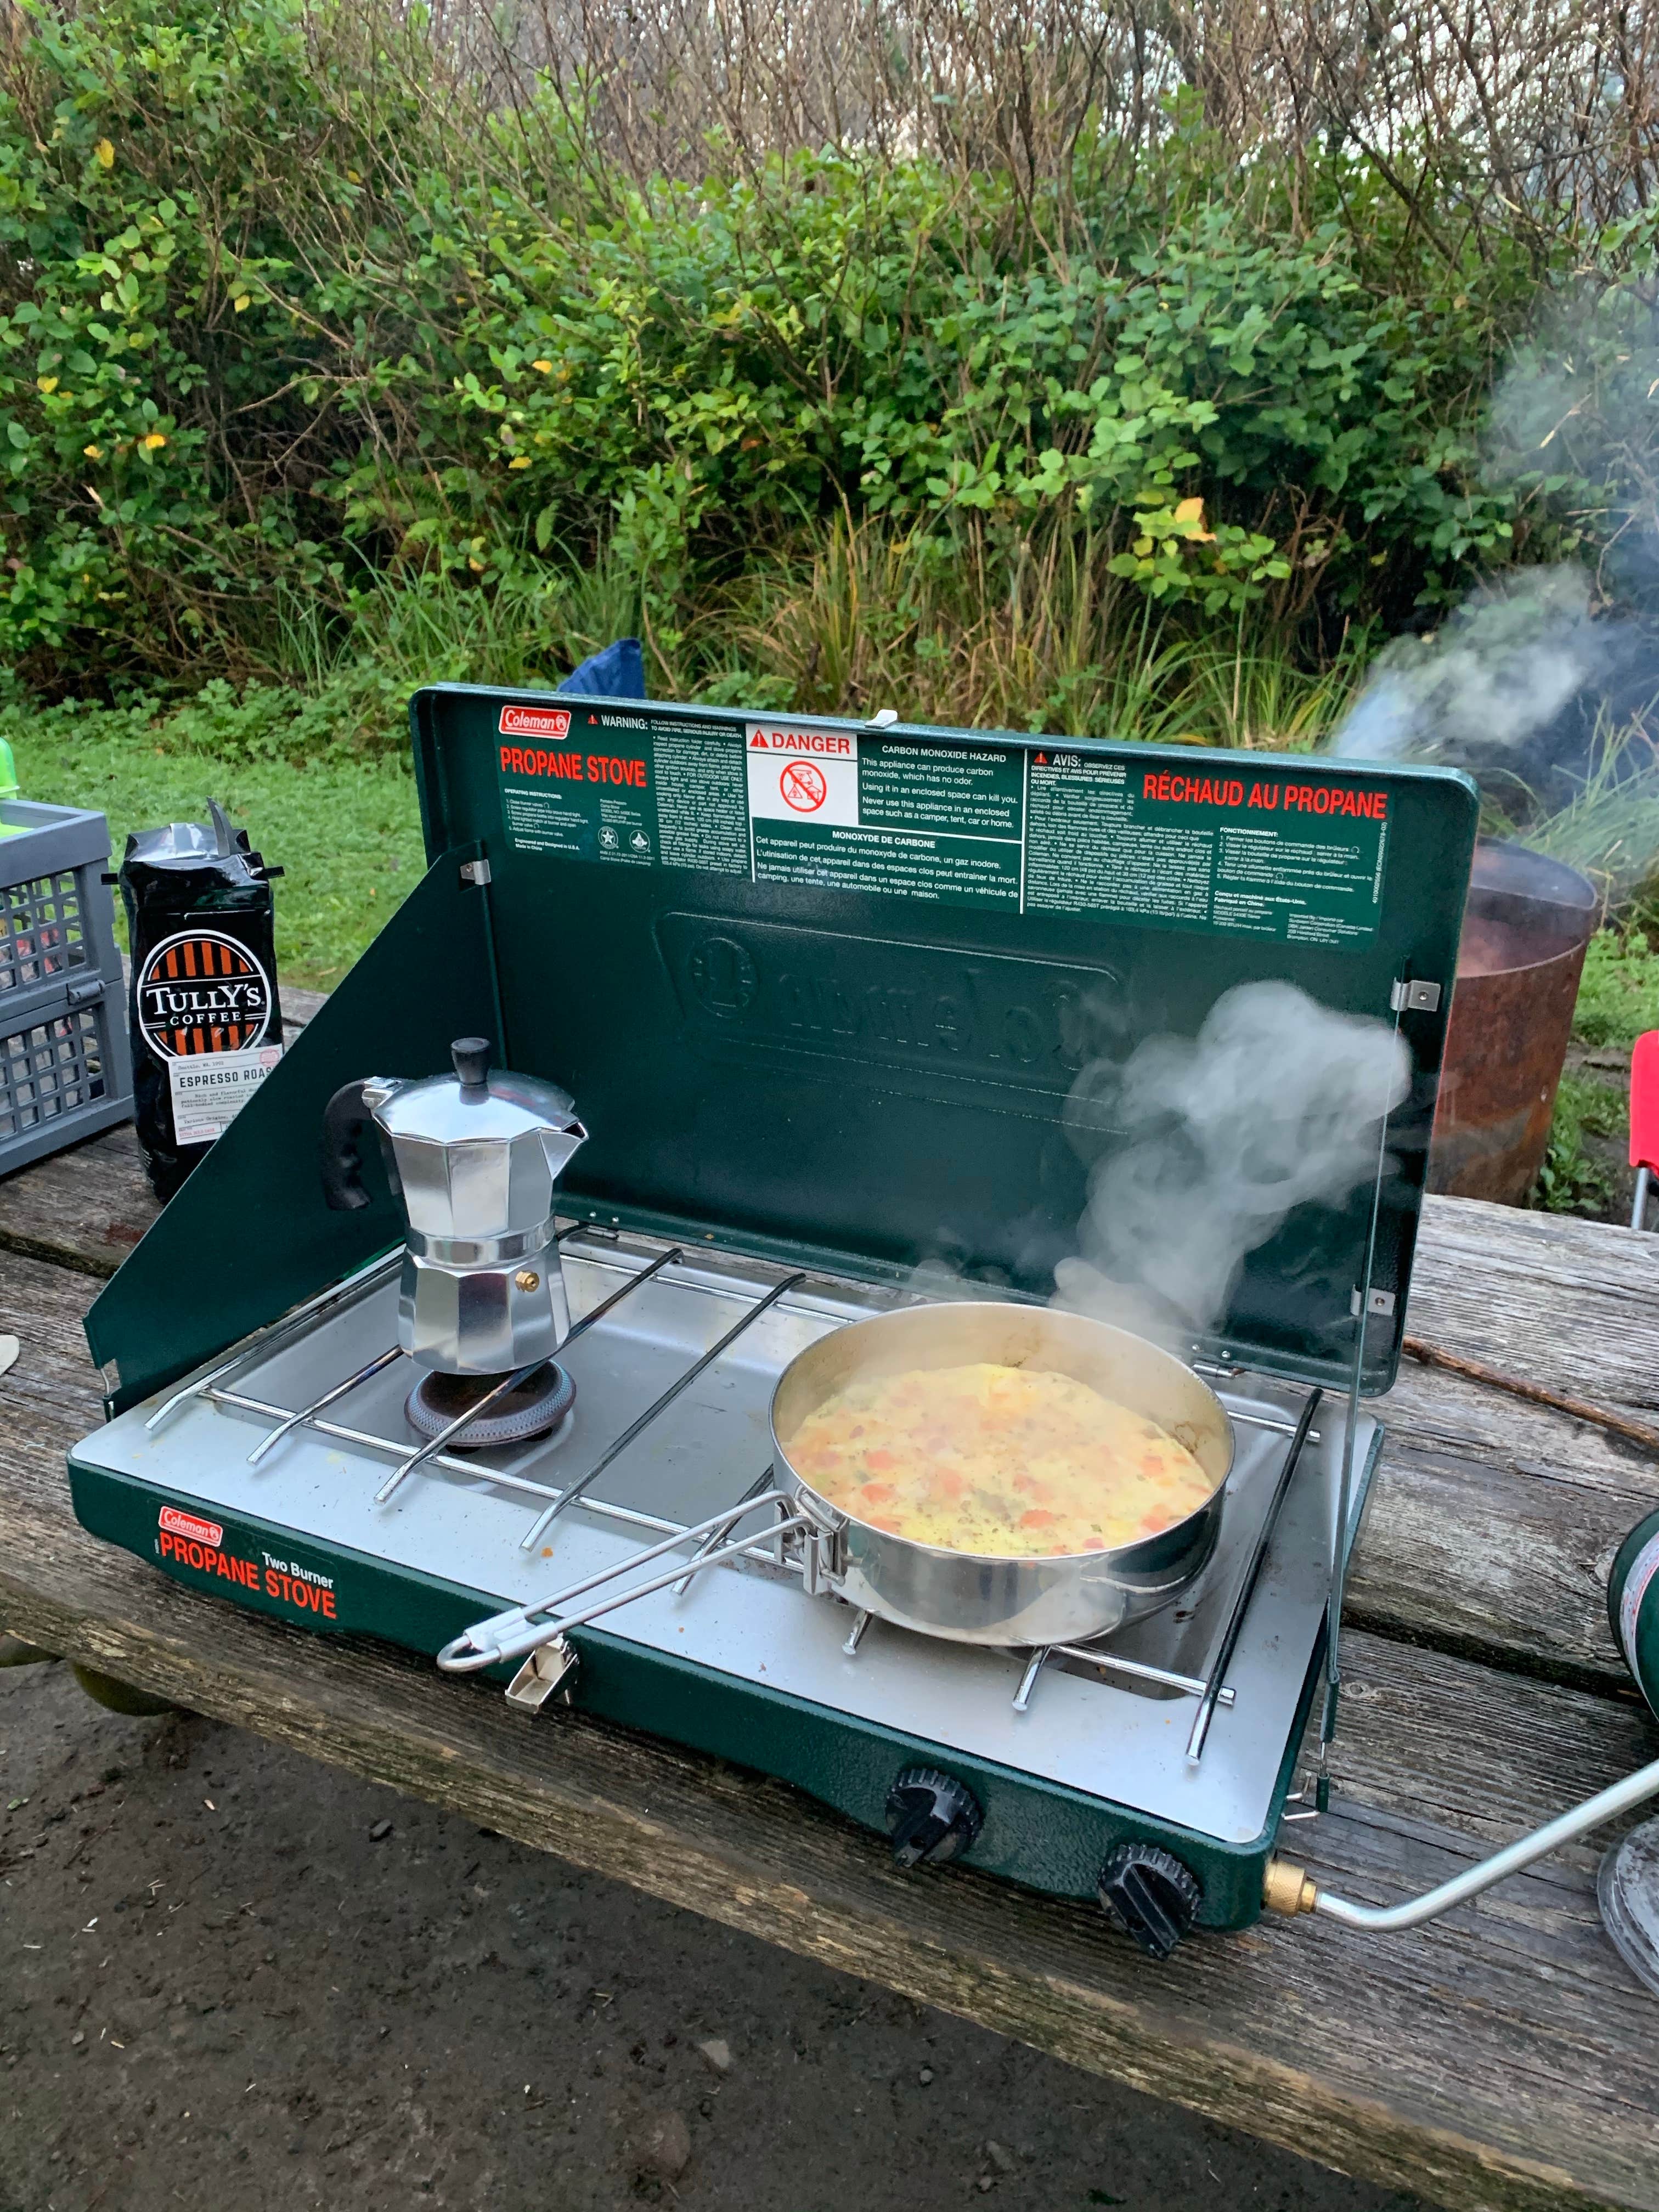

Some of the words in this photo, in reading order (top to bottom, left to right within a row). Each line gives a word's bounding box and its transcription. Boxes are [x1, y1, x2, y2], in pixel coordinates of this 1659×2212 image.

[505, 710, 555, 730] Coleman
[601, 715, 648, 730] WARNING:
[772, 732, 850, 754] DANGER
[882, 745, 918, 755] CARBON
[921, 748, 967, 759] MONOXIDE
[969, 752, 1006, 762] HAZARD
[1053, 754, 1081, 767] AVIS:
[500, 746, 583, 781] PROPANE
[587, 755, 647, 787] STOVE
[862, 757, 877, 766] This
[879, 760, 915, 769] appliance
[933, 765, 964, 774] produce
[966, 768, 993, 776] carbon
[862, 770, 900, 779] monoxide,
[953, 777, 973, 785] odor.
[862, 782, 883, 793] Using
[911, 788, 946, 797] enclosed
[1143, 770, 1243, 806] RÉCHAUD
[1248, 783, 1278, 809] AU
[1283, 785, 1387, 819] PROPANE
[862, 796, 884, 805] Never
[916, 802, 952, 811] appliance
[974, 808, 1009, 816] enclosed
[919, 813, 949, 822] camper,
[950, 815, 966, 824] tent,
[990, 819, 1013, 827] home.
[832, 831, 879, 842] MONOXYDE
[881, 836, 893, 844] DE
[894, 837, 935, 848] CARBONE
[755, 836, 768, 844] Cet
[816, 844, 846, 852] produire
[858, 848, 896, 858] monoxyde
[909, 854, 941, 863] carbone,
[970, 859, 1001, 869] inodore.
[822, 857, 850, 866] appareil
[851, 860, 870, 868] dans
[886, 865, 917, 873] espaces
[757, 861, 767, 870] Ne
[768, 864, 791, 872] jamais
[792, 866, 815, 875] utiliser
[828, 871, 857, 879] appareil
[859, 873, 877, 882] dans
[889, 878, 916, 886] espace
[934, 883, 962, 891] comme
[842, 882, 881, 892] automobile
[911, 890, 939, 899] maison.
[146, 984, 261, 1015] TULLY'S
[170, 1011, 241, 1025] COFFEE
[180, 1071, 238, 1088] ESPRESSO
[244, 1066, 275, 1080] ROAS
[164, 1510, 208, 1537] Coleman
[160, 1531, 260, 1591] PROPANE
[265, 1569, 337, 1620] STOVE
[262, 1551, 288, 1573] Two
[291, 1562, 334, 1589] Burner
